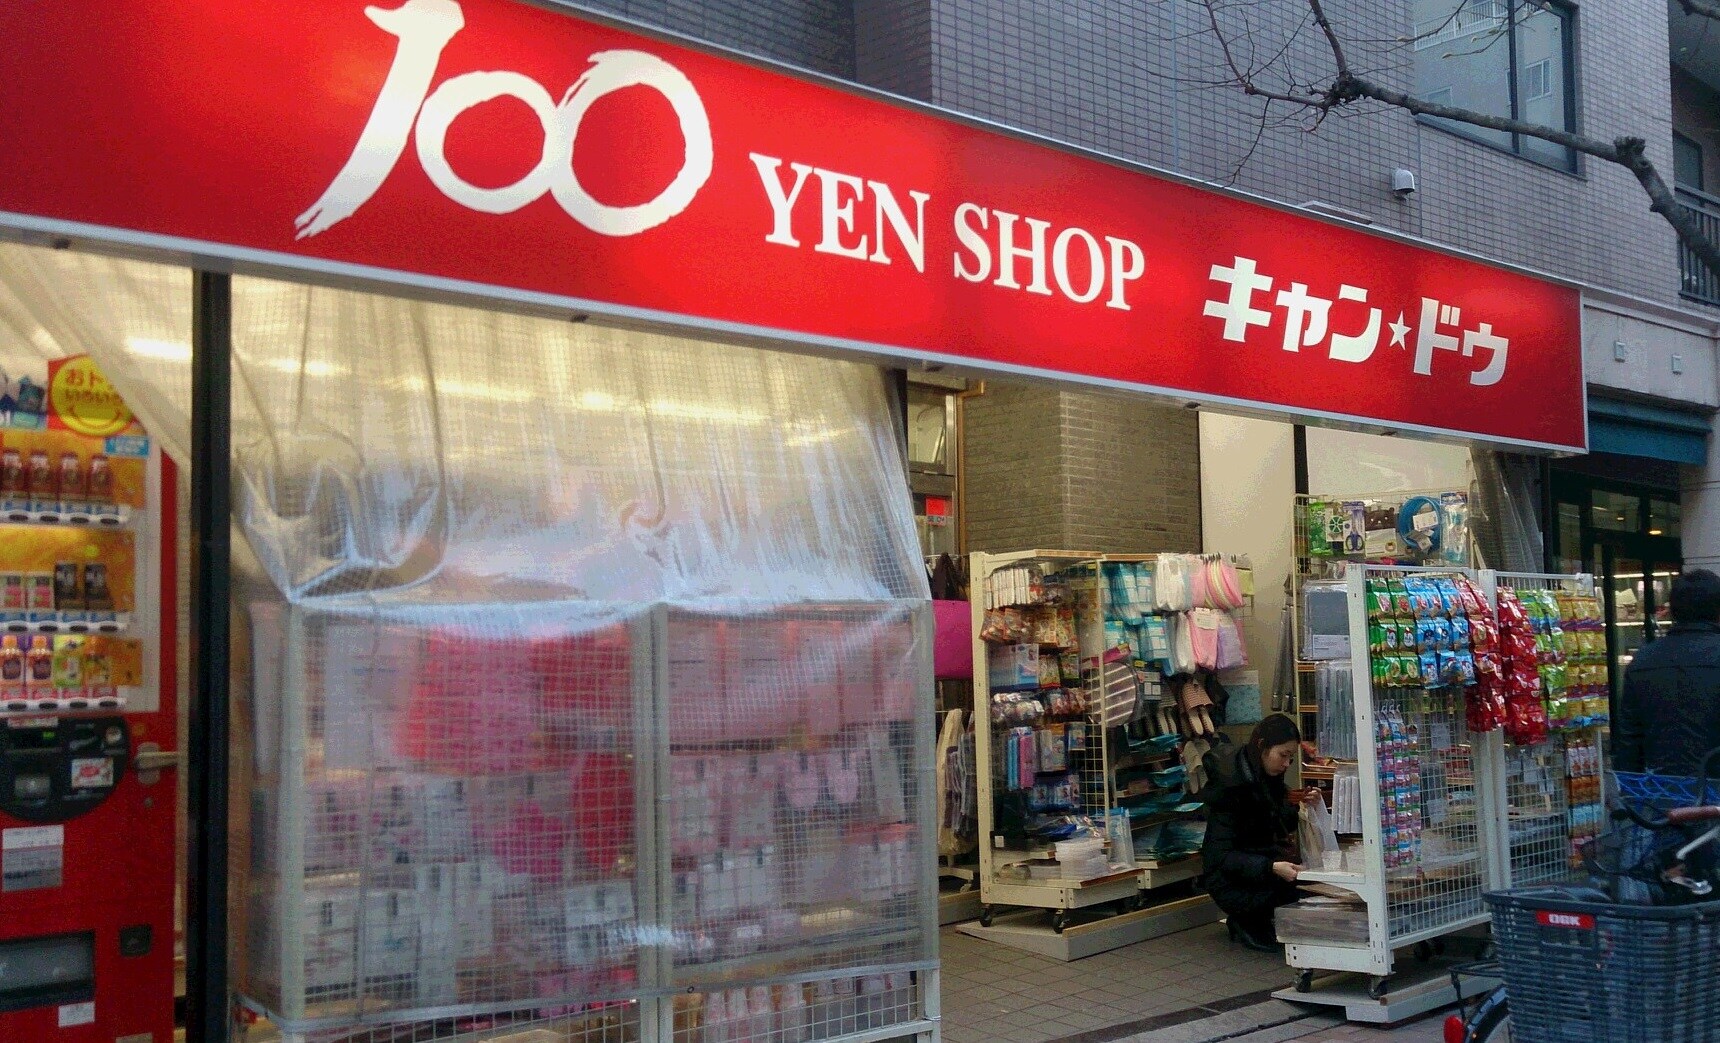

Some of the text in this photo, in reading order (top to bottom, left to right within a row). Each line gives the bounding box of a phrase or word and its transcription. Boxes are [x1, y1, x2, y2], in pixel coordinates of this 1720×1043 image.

[295, 0, 1145, 311] 100 YEN SHOP
